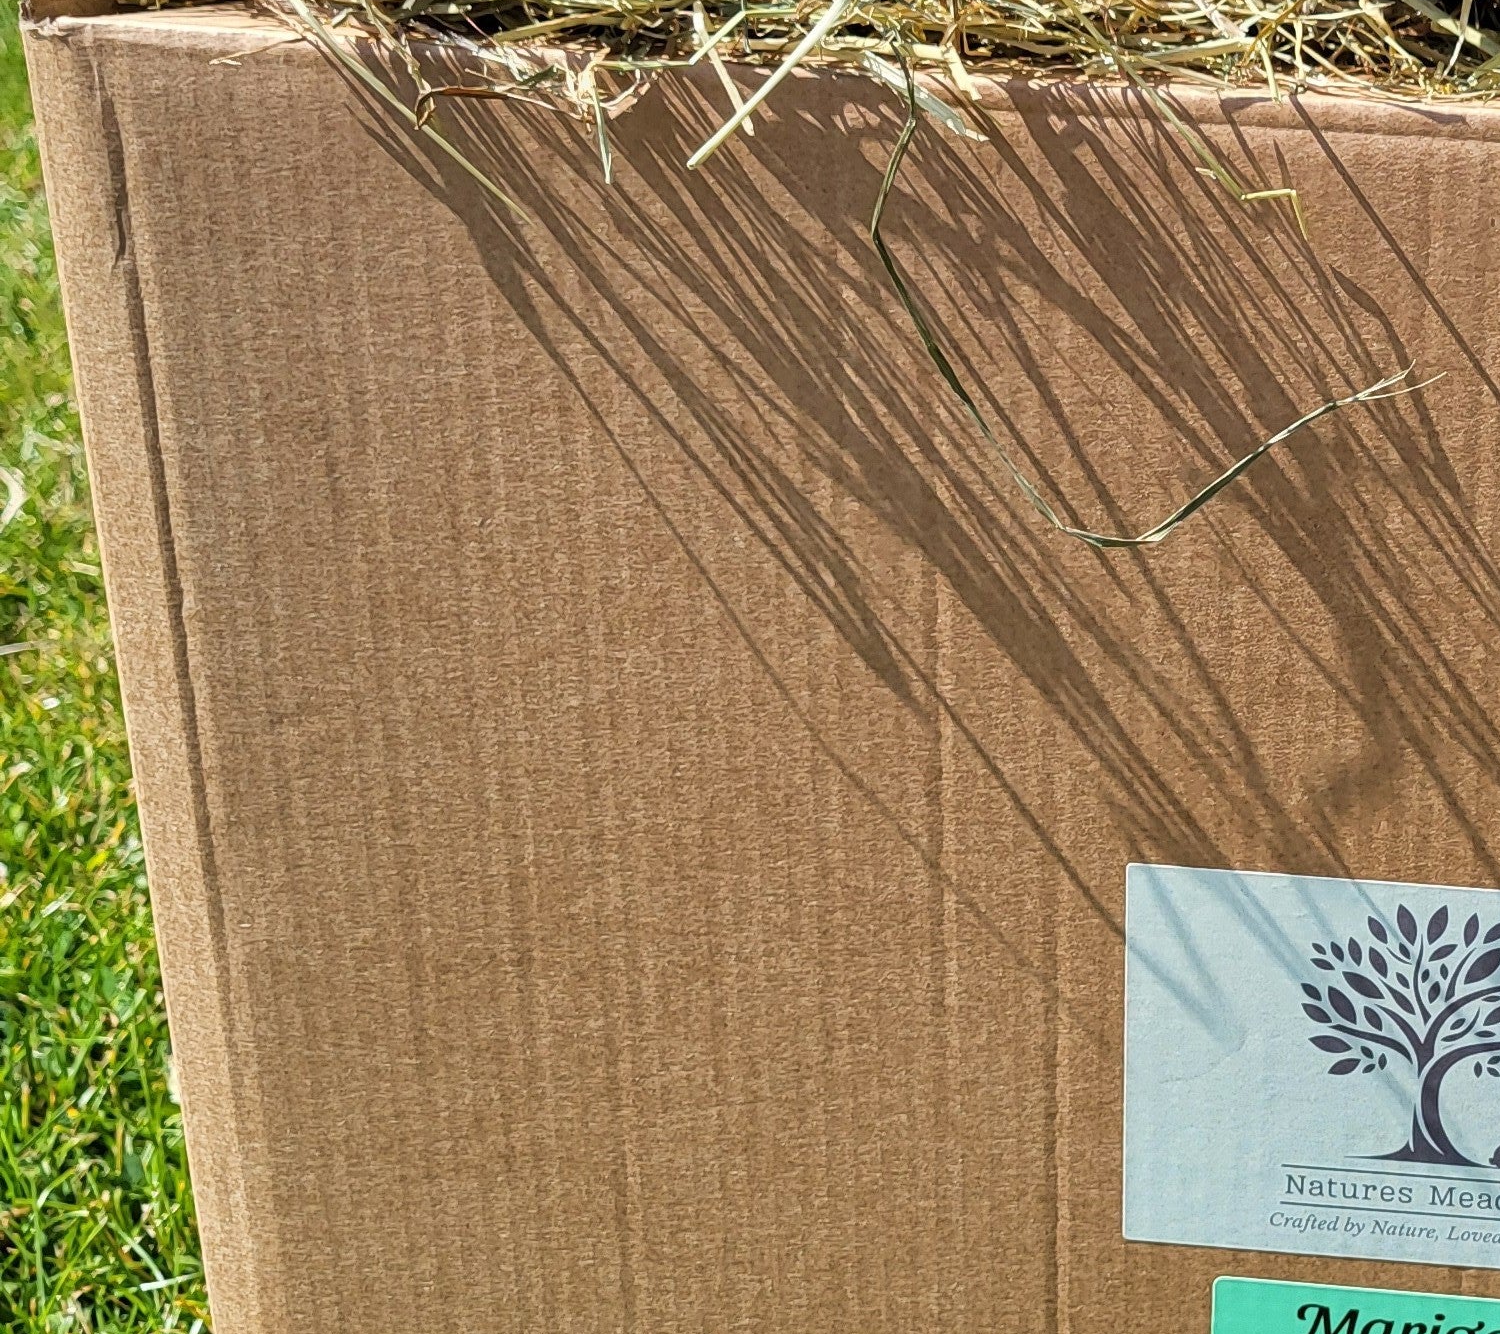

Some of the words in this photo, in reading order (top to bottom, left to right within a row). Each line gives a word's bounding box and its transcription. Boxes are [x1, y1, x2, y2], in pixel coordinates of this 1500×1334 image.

[1284, 1174, 1414, 1204] Natures
[1269, 1211, 1339, 1233] Crafted
[1344, 1218, 1366, 1237] by
[1370, 1219, 1440, 1242] Nature,
